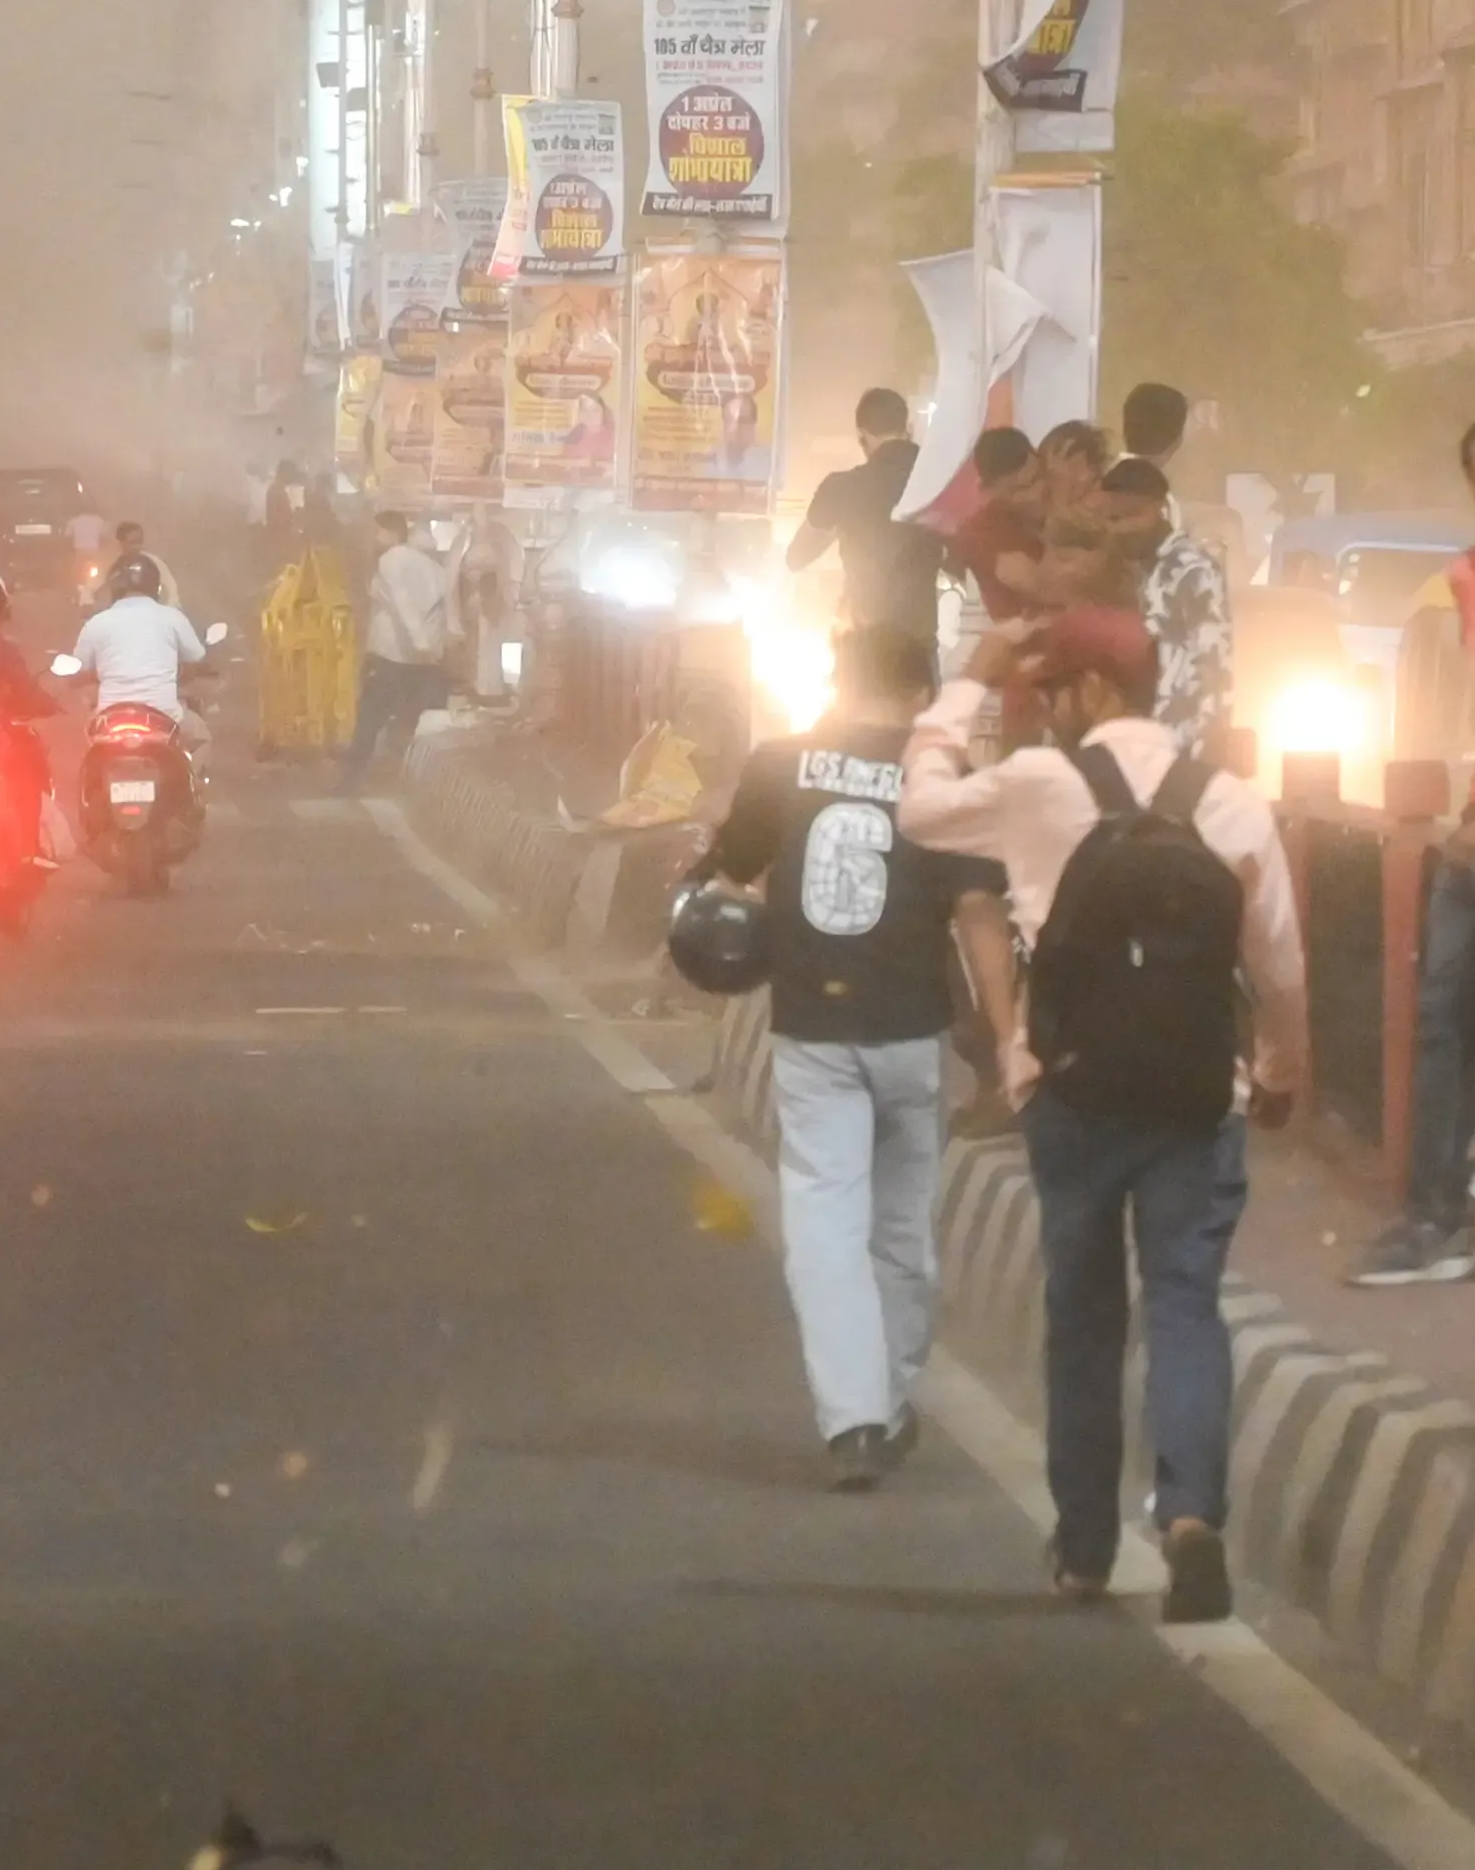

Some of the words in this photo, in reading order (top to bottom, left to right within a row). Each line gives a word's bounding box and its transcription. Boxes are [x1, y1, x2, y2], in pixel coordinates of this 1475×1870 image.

[654, 37, 676, 56] 105
[700, 33, 727, 55] चैत्र
[730, 35, 766, 56] मेला
[681, 96, 689, 112] 1
[713, 116, 723, 130] 3
[801, 801, 893, 936] 6
